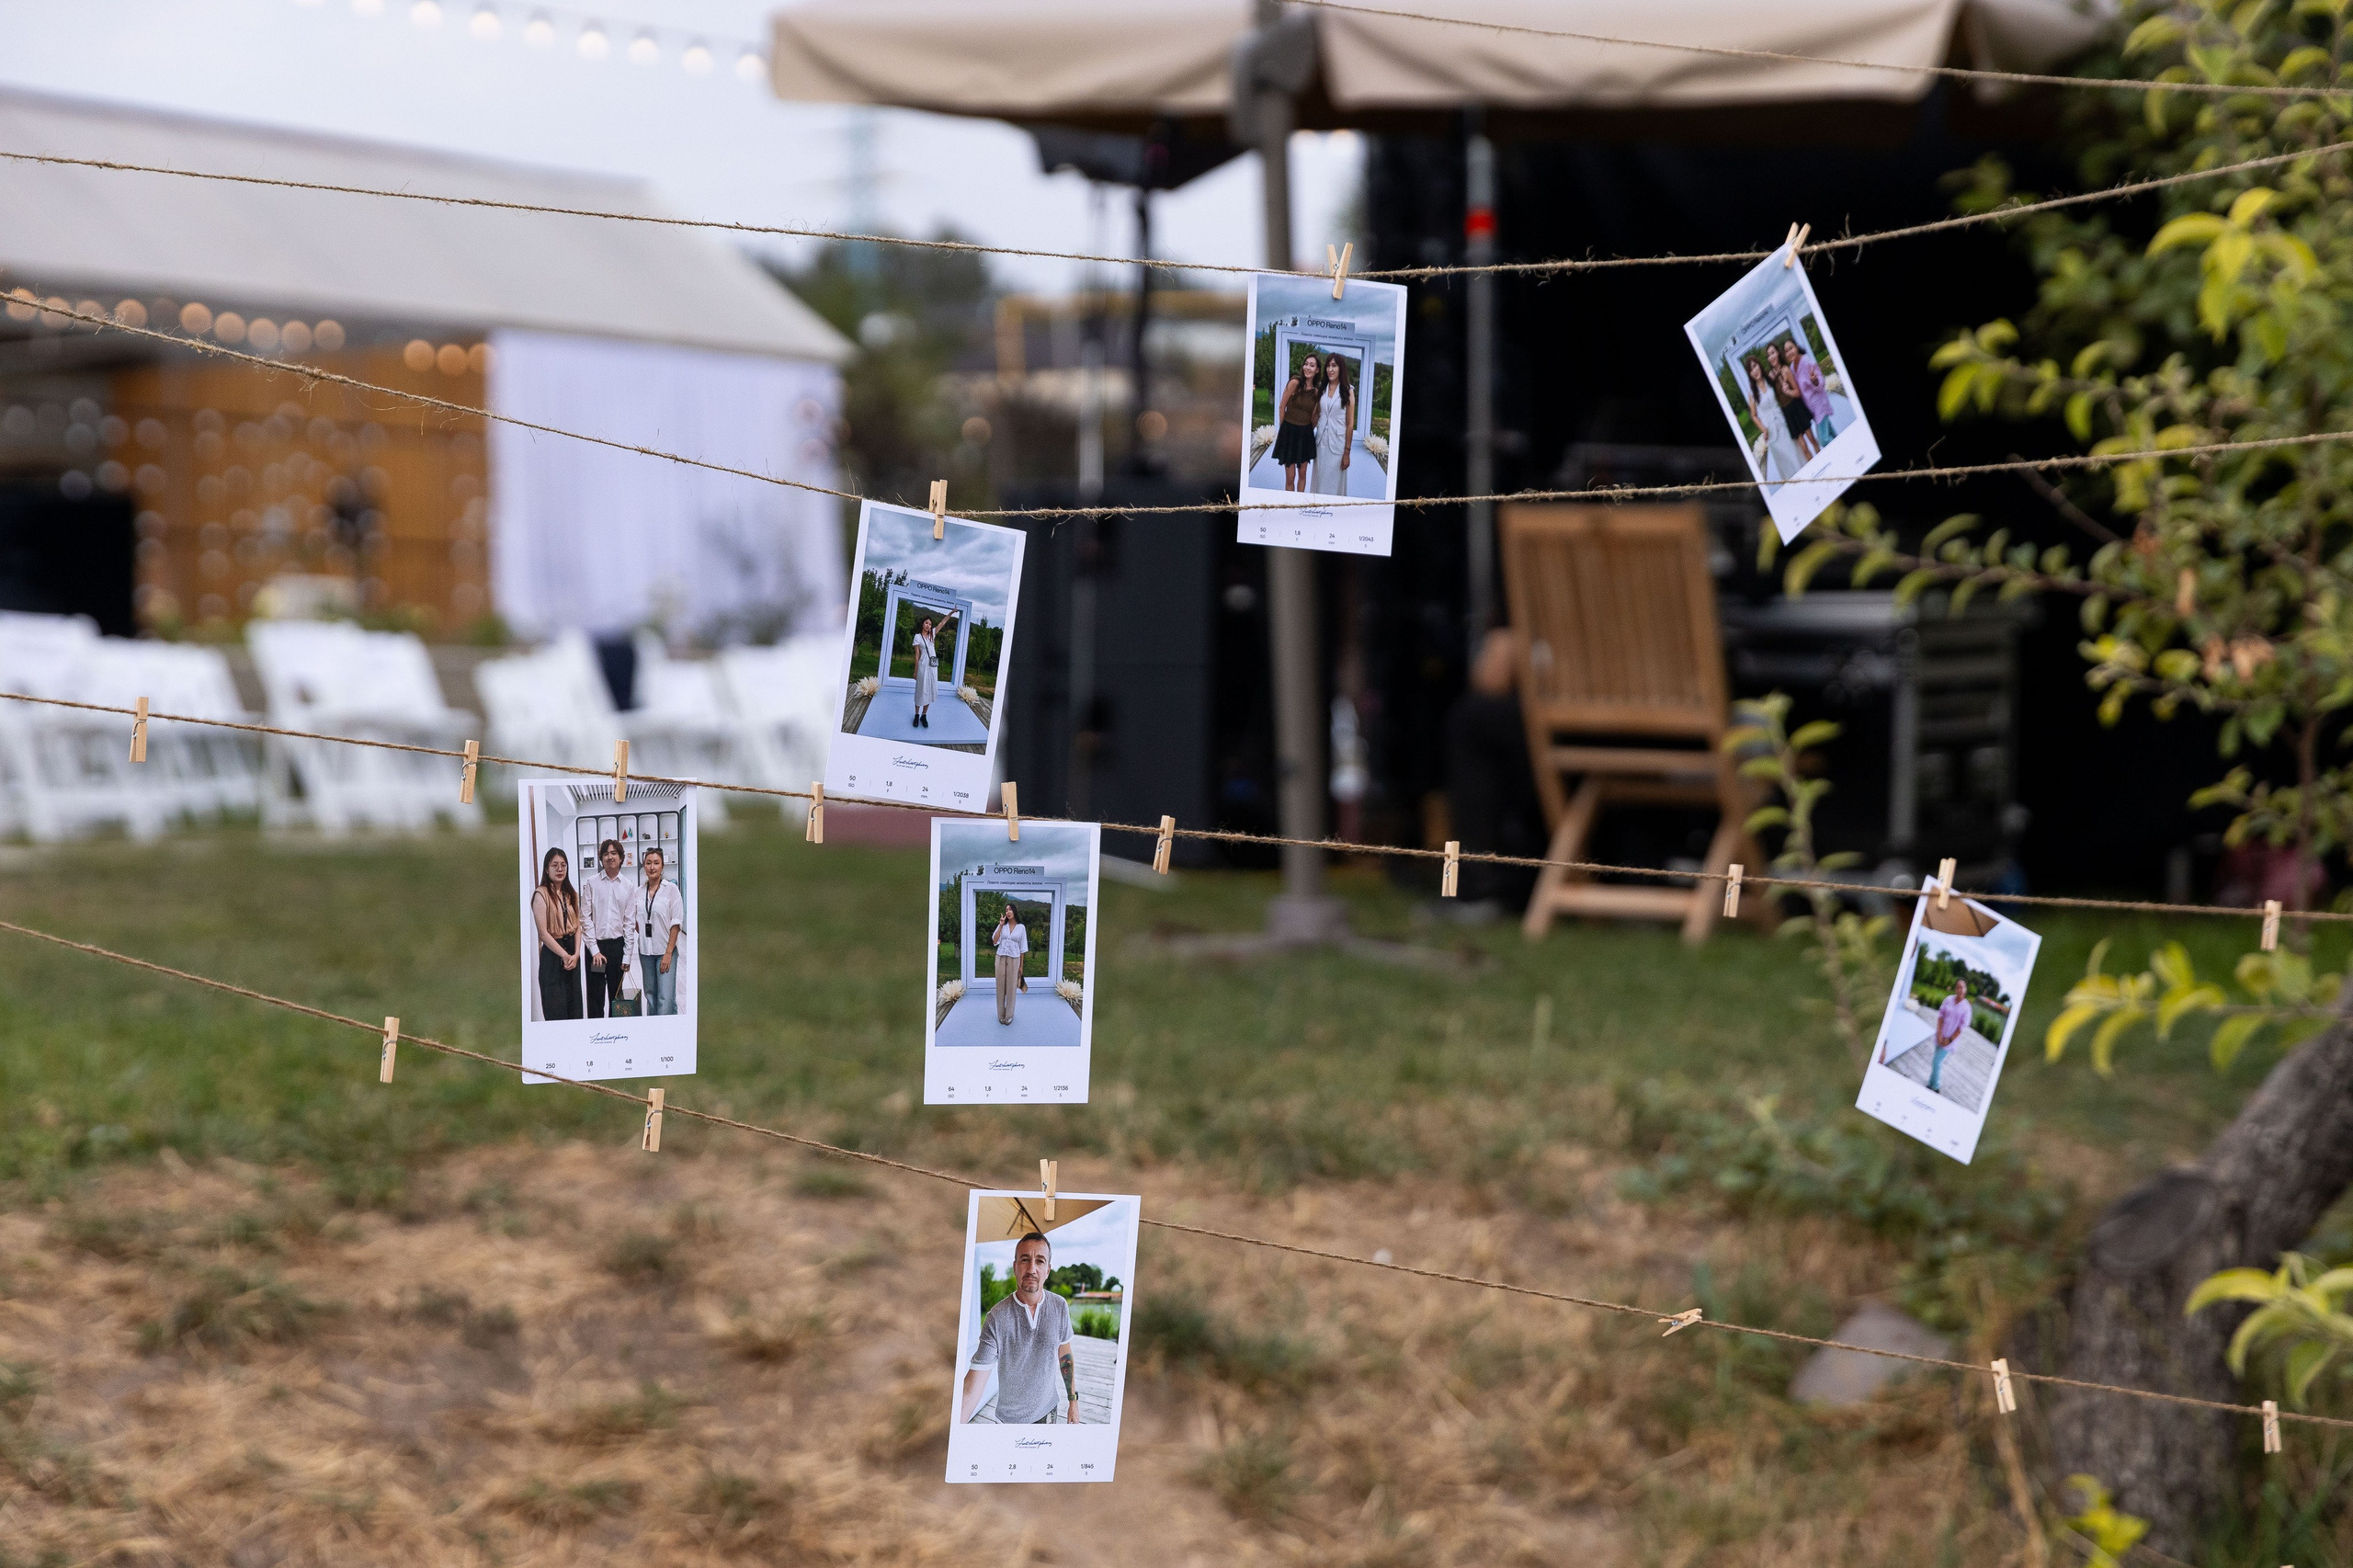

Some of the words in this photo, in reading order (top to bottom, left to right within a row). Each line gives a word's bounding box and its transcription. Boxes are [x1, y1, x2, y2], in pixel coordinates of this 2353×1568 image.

[1307, 319, 1325, 328] OPPO
[916, 582, 933, 592] OPPO
[993, 867, 1013, 875] OPPO
[1013, 867, 1036, 875] Reno14
